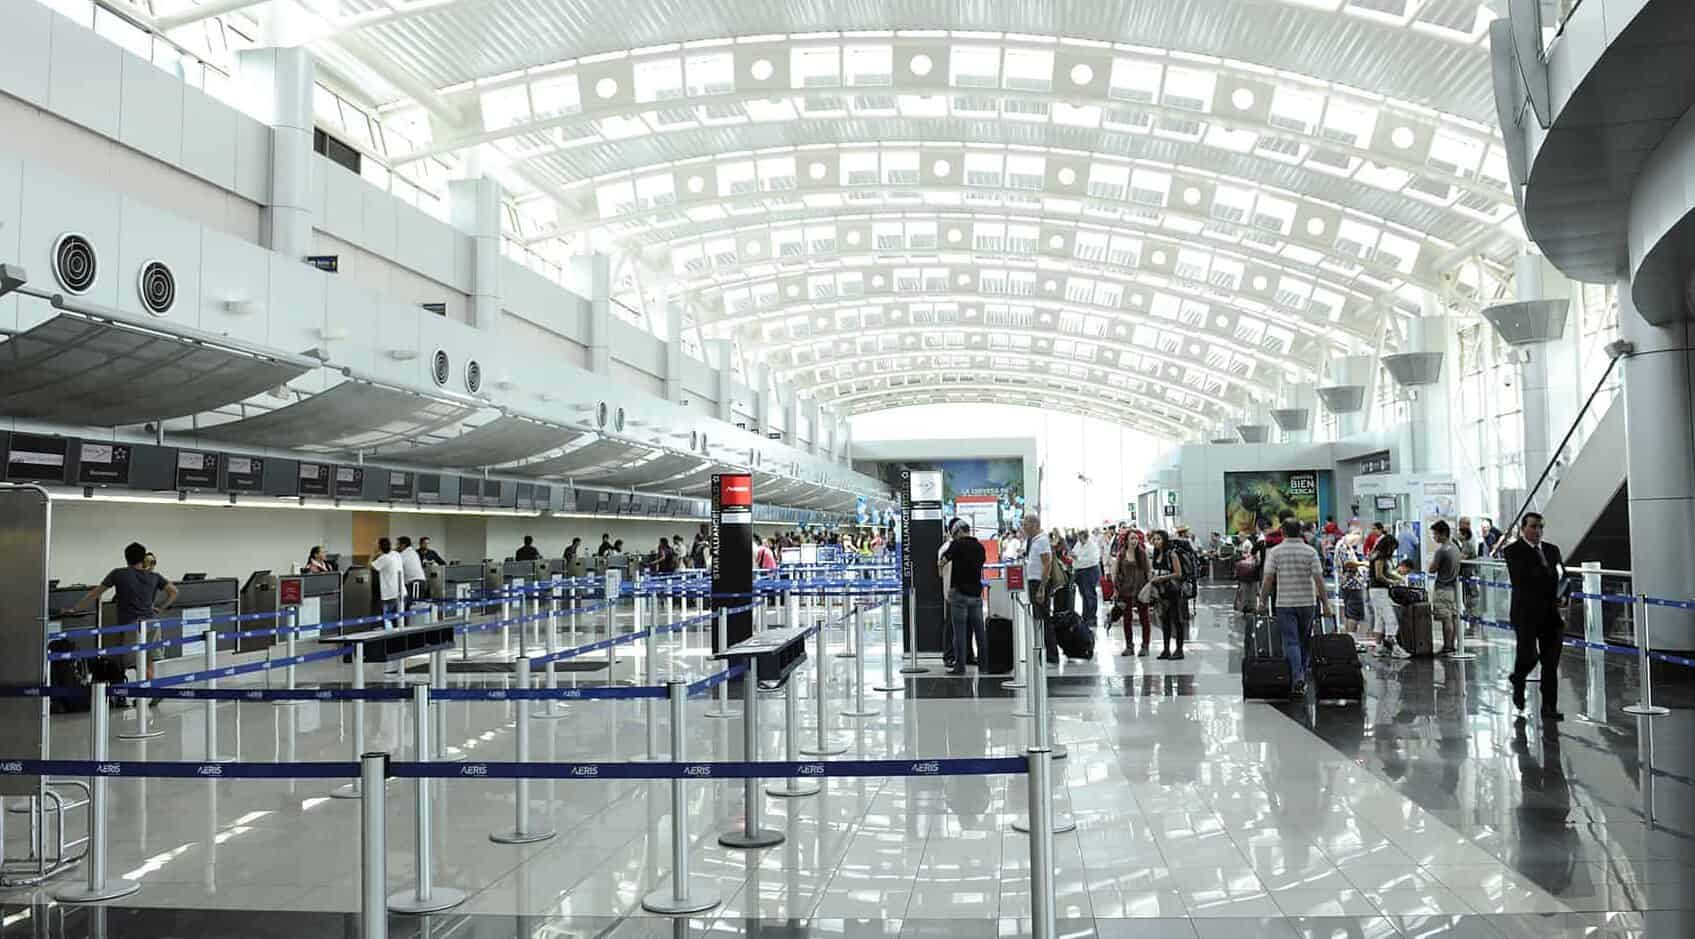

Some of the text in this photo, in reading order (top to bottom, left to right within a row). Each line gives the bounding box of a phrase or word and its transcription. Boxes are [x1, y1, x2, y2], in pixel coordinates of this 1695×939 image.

[1290, 479, 1314, 489] BIEN
[712, 513, 721, 556] ALLIANCE
[902, 510, 911, 553] ALLIANCE
[712, 556, 721, 578] STAR
[903, 554, 911, 577] STAR
[96, 763, 121, 773] AERIS
[197, 764, 223, 775] AERIS
[461, 764, 488, 775] AERIS
[571, 765, 599, 776] AERIS
[684, 765, 712, 776] AERIS
[798, 763, 825, 774] AERIS
[912, 761, 940, 772] AERIS
